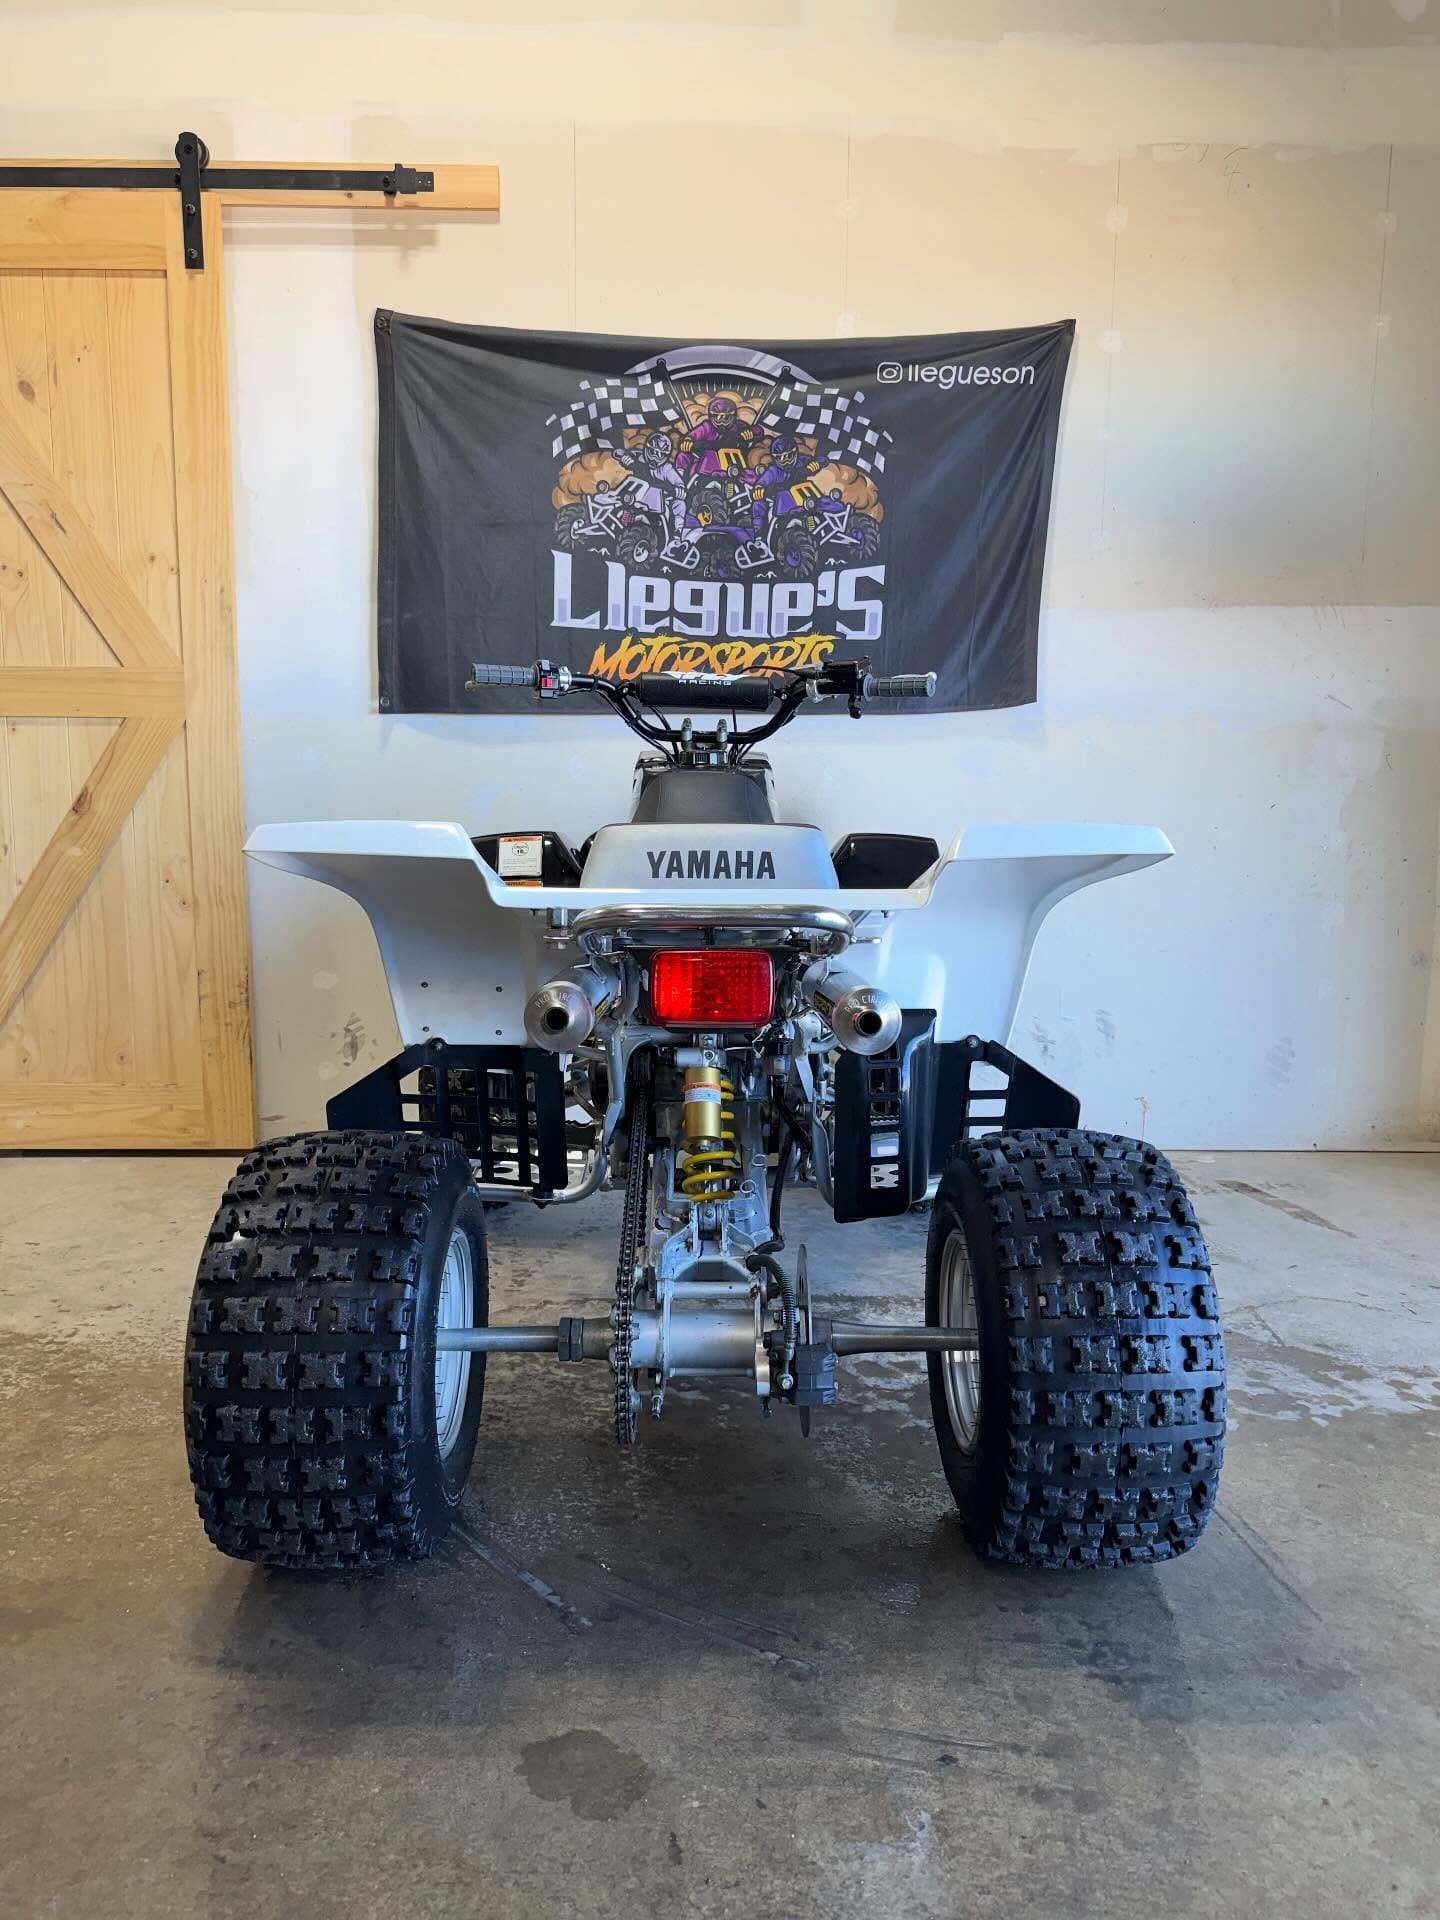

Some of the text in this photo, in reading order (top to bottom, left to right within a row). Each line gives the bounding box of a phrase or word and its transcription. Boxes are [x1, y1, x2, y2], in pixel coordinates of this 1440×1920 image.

[908, 364, 1035, 390] llegueson
[587, 633, 840, 681] MOTORSPORTS
[646, 850, 776, 880] YAMAHA
